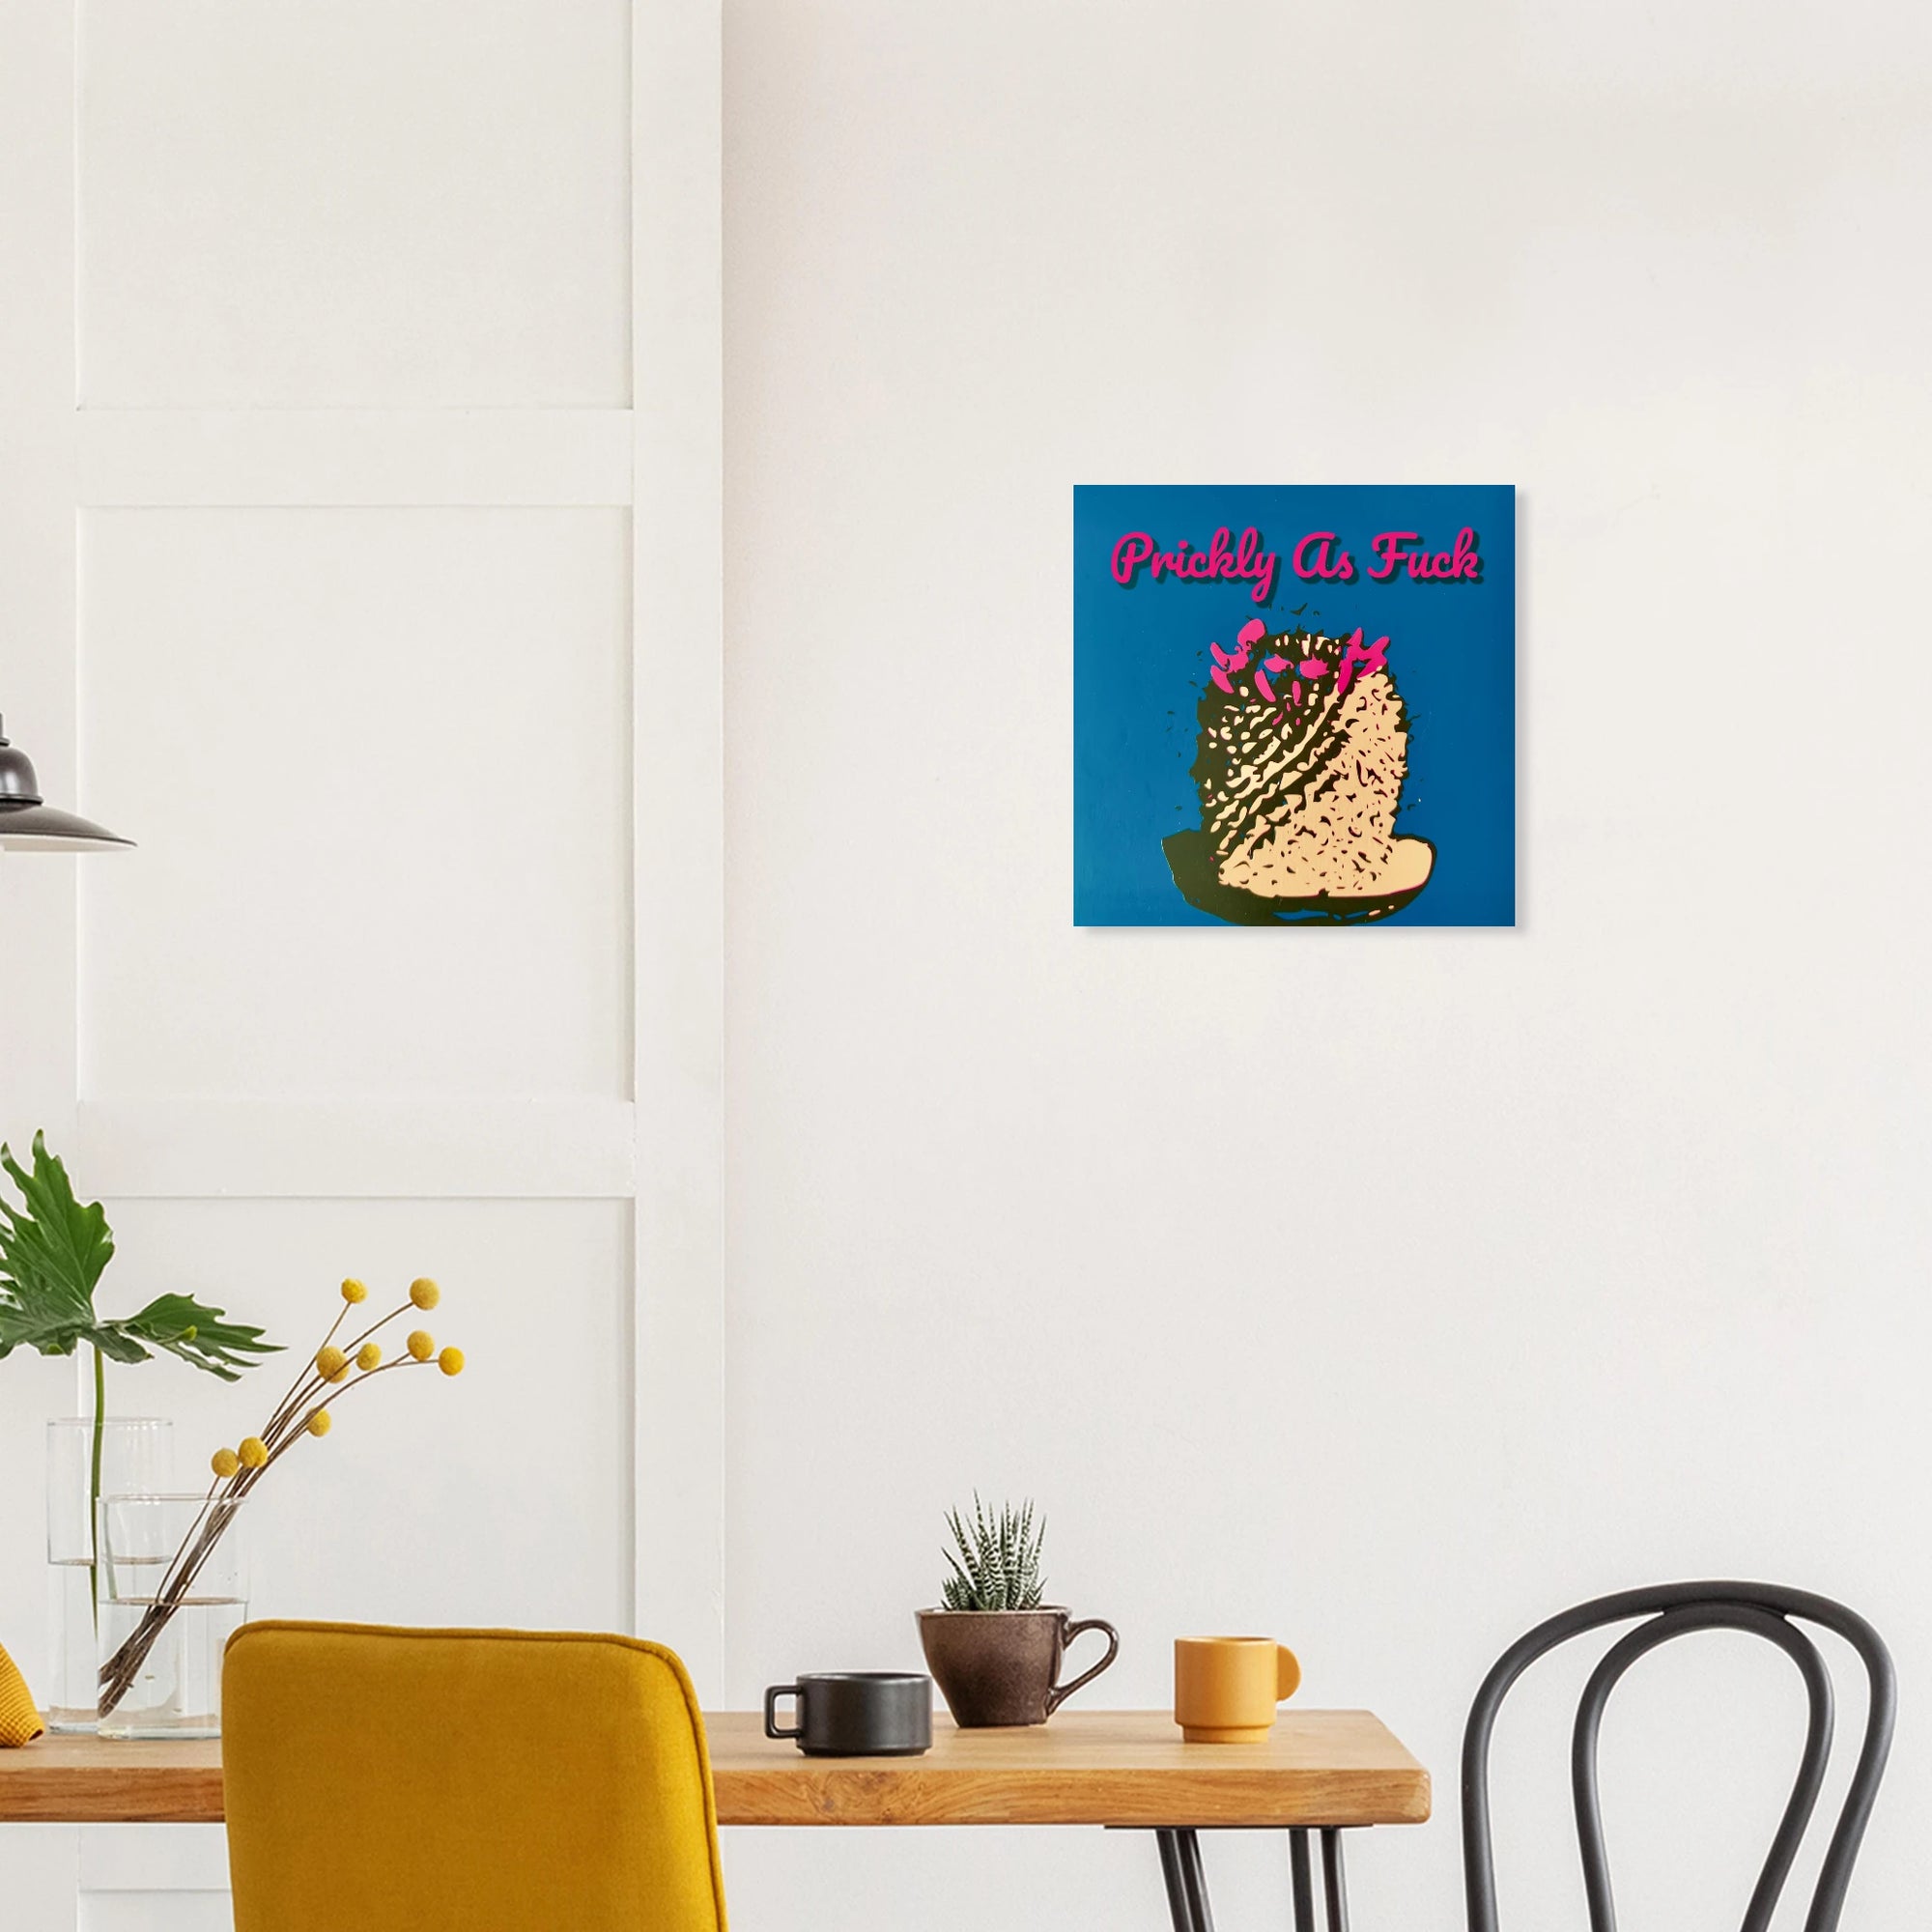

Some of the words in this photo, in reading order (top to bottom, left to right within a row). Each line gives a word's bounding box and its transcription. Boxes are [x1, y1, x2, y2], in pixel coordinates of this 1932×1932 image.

[1110, 526, 1276, 603] Prickly
[1293, 531, 1354, 580] As
[1367, 526, 1479, 579] Fuck
